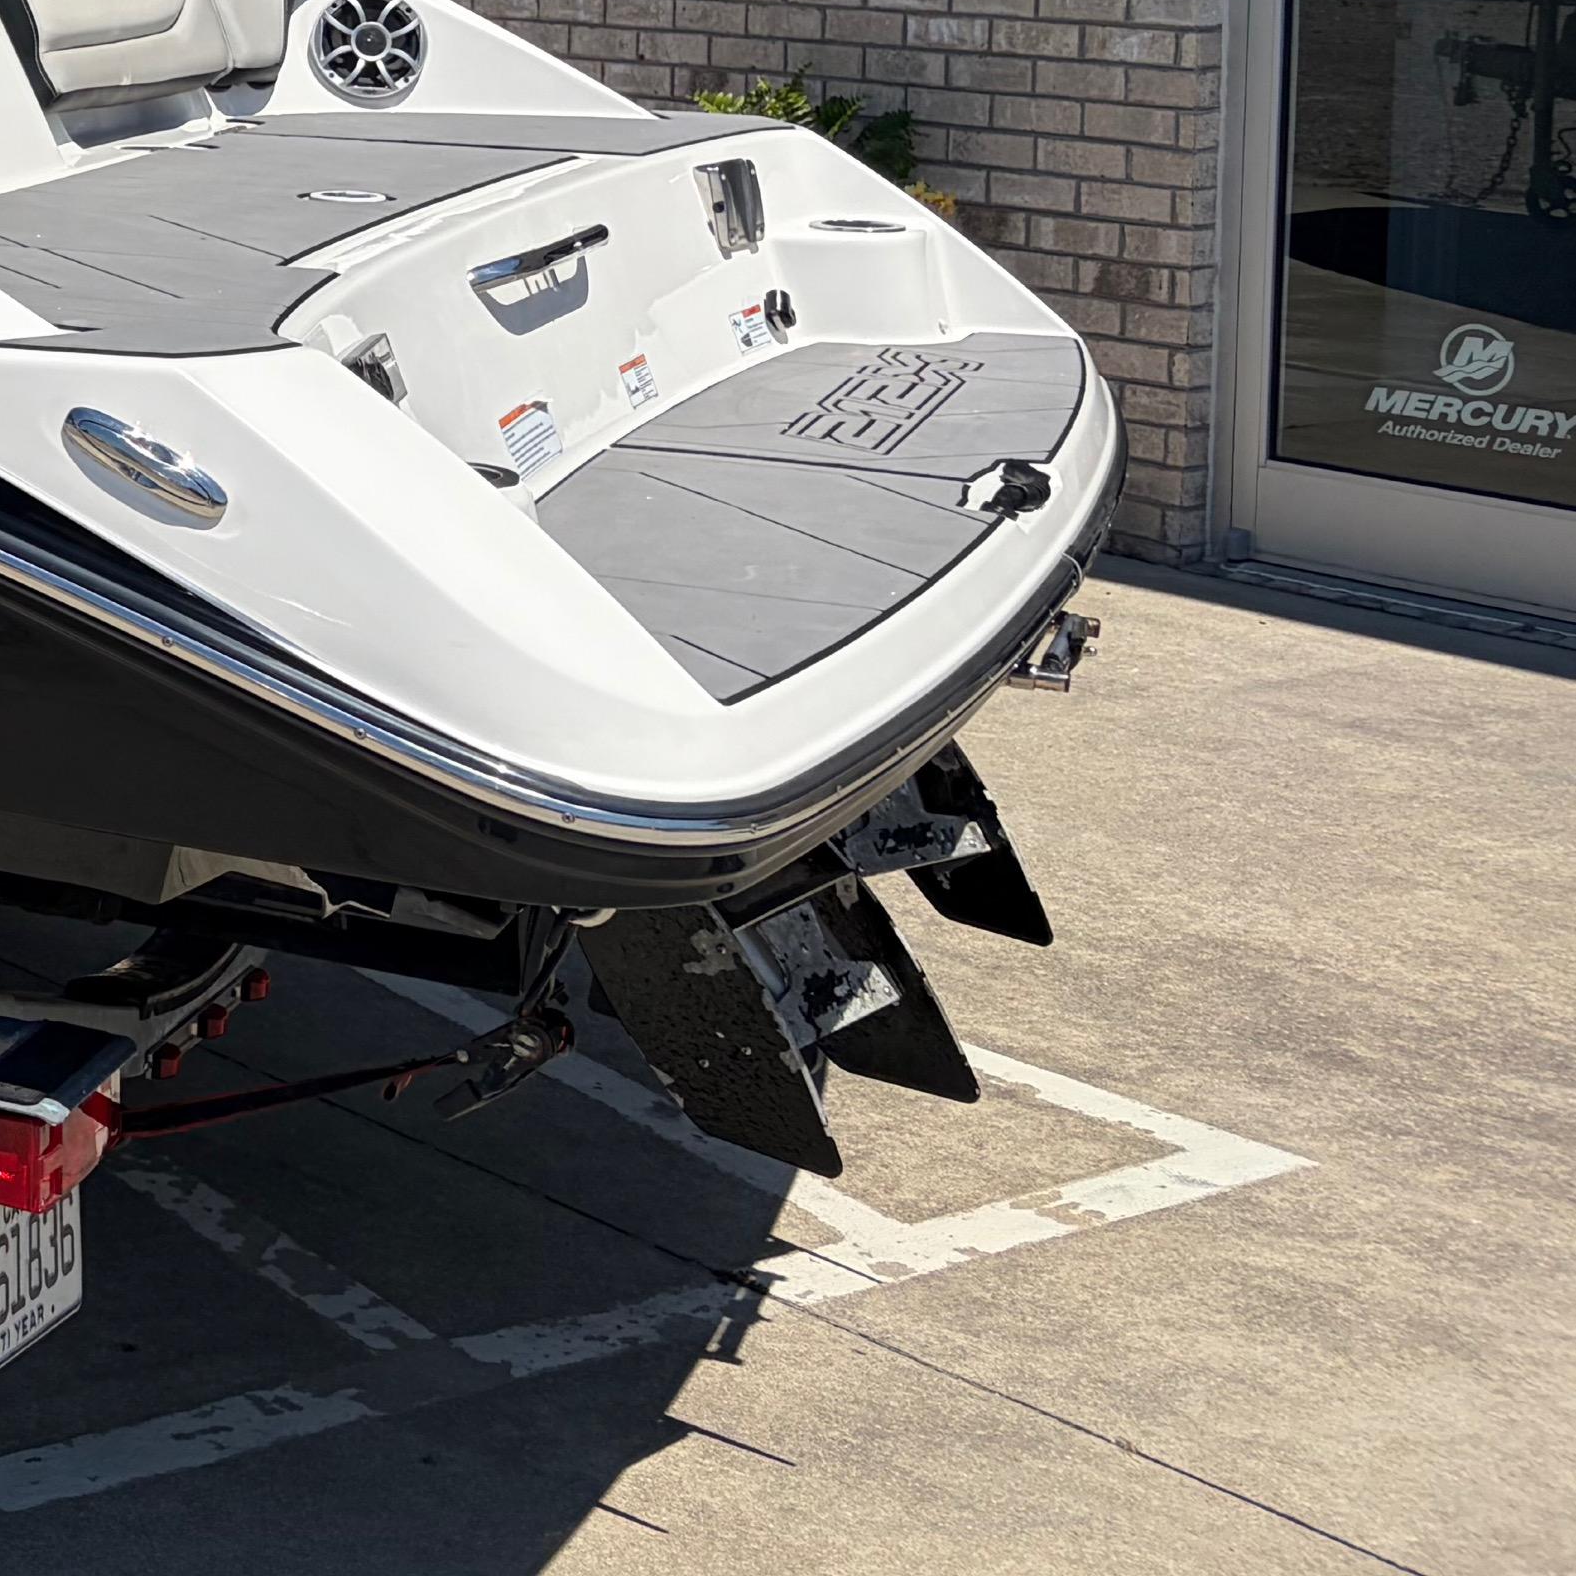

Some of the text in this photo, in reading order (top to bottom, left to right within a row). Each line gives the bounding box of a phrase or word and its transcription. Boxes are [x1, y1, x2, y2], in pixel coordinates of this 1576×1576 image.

[1364, 387, 1576, 440] MERCURY
[1378, 420, 1562, 459] Authorized Dealer
[14, 1304, 45, 1337] YEAR
